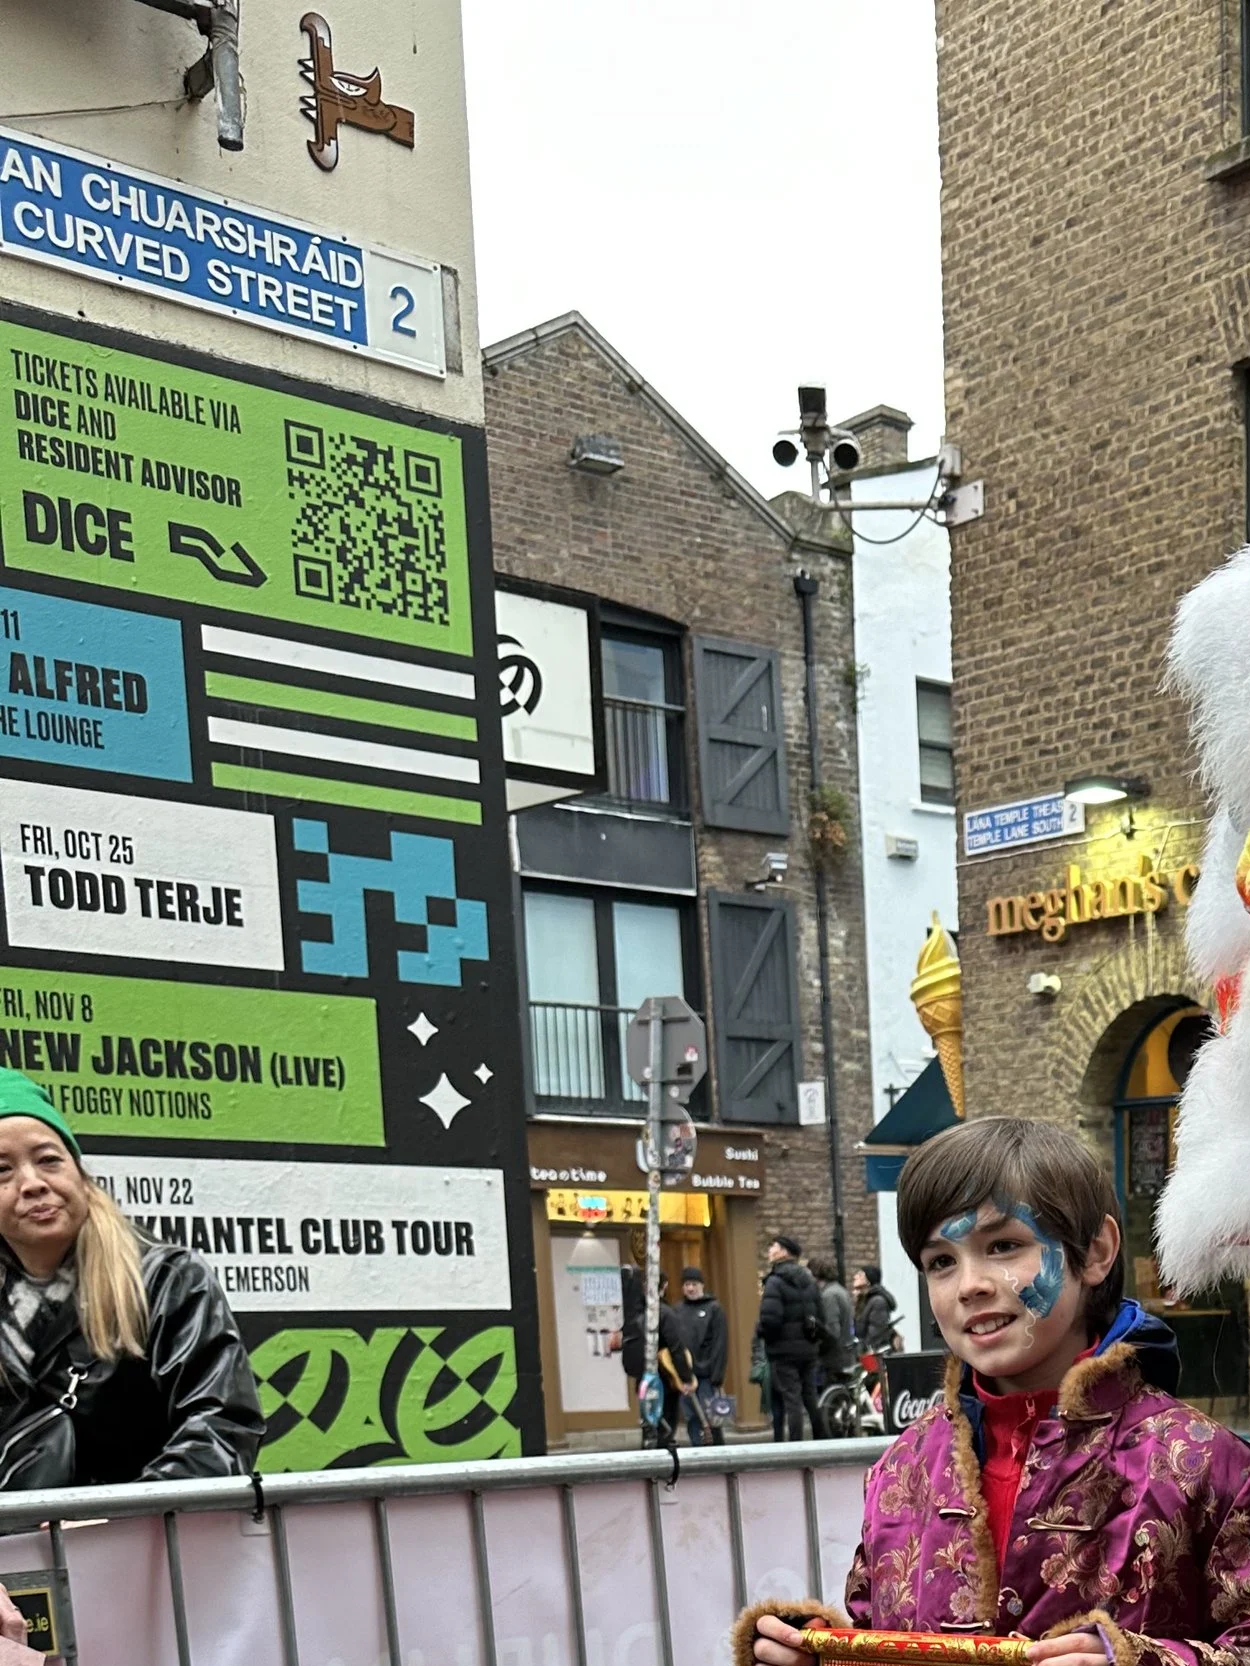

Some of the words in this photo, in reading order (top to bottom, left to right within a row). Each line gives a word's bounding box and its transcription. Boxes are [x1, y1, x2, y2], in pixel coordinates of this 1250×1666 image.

[1, 148, 62, 198] AN
[81, 173, 364, 289] CHUARSHRÁID
[13, 202, 191, 283] CURVED
[207, 259, 358, 332] STREET
[389, 285, 416, 337] 2
[11, 349, 98, 399] TICKETS
[104, 372, 206, 427] AVAILABLE
[210, 400, 241, 434] VIA
[14, 390, 72, 431] DICE
[77, 405, 117, 441] AND
[18, 429, 134, 484] RESIDENT
[141, 460, 243, 507] ADVISOR
[22, 489, 135, 563] DICE
[0, 608, 20, 641] 11
[9, 651, 148, 715] ALFRED
[24, 708, 105, 750] LOUNGE
[968, 829, 1001, 847] TEMPLE
[1003, 824, 1029, 840] LANE
[1031, 817, 1064, 834] SOUTH
[994, 808, 1029, 827] TEMPLE
[1069, 803, 1077, 822] 2
[20, 823, 60, 861] FRI,
[64, 829, 102, 862] OCT
[108, 834, 134, 866] 25
[24, 866, 127, 915] TODD
[135, 877, 244, 928] TERJE
[986, 855, 1162, 942] meghan's
[0, 987, 31, 1022] RI,
[35, 990, 75, 1021] NOV
[81, 994, 93, 1023] 8
[0, 1028, 81, 1073] NEW
[91, 1036, 263, 1083] JACKSON
[270, 1052, 346, 1091] (LIVE)
[60, 1084, 124, 1116] FOGGY
[130, 1087, 212, 1120] NOTIONS
[725, 1147, 758, 1161] Sushi
[92, 1177, 122, 1208] RI,
[126, 1177, 163, 1204] NOV
[169, 1177, 194, 1205] 22
[691, 1174, 735, 1188] Bubble
[738, 1176, 761, 1189] Tea
[300, 1218, 385, 1256] CLUB
[392, 1220, 475, 1257] TOUR
[225, 1266, 310, 1292] EMERSON
